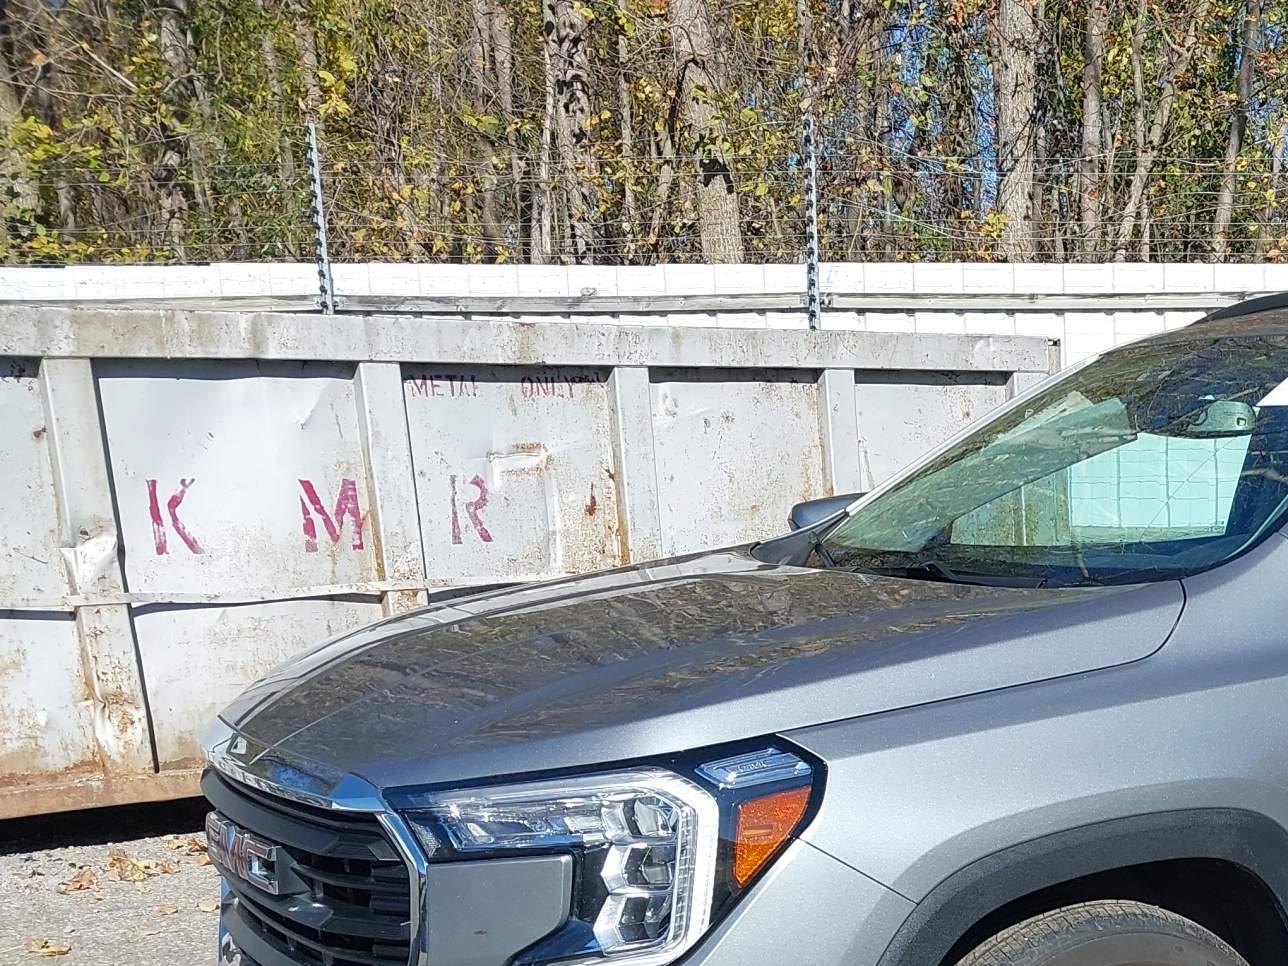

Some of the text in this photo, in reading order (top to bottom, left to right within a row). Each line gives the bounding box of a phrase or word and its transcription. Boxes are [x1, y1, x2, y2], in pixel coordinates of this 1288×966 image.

[146, 474, 494, 555] K M R
[205, 811, 279, 896] GMC
